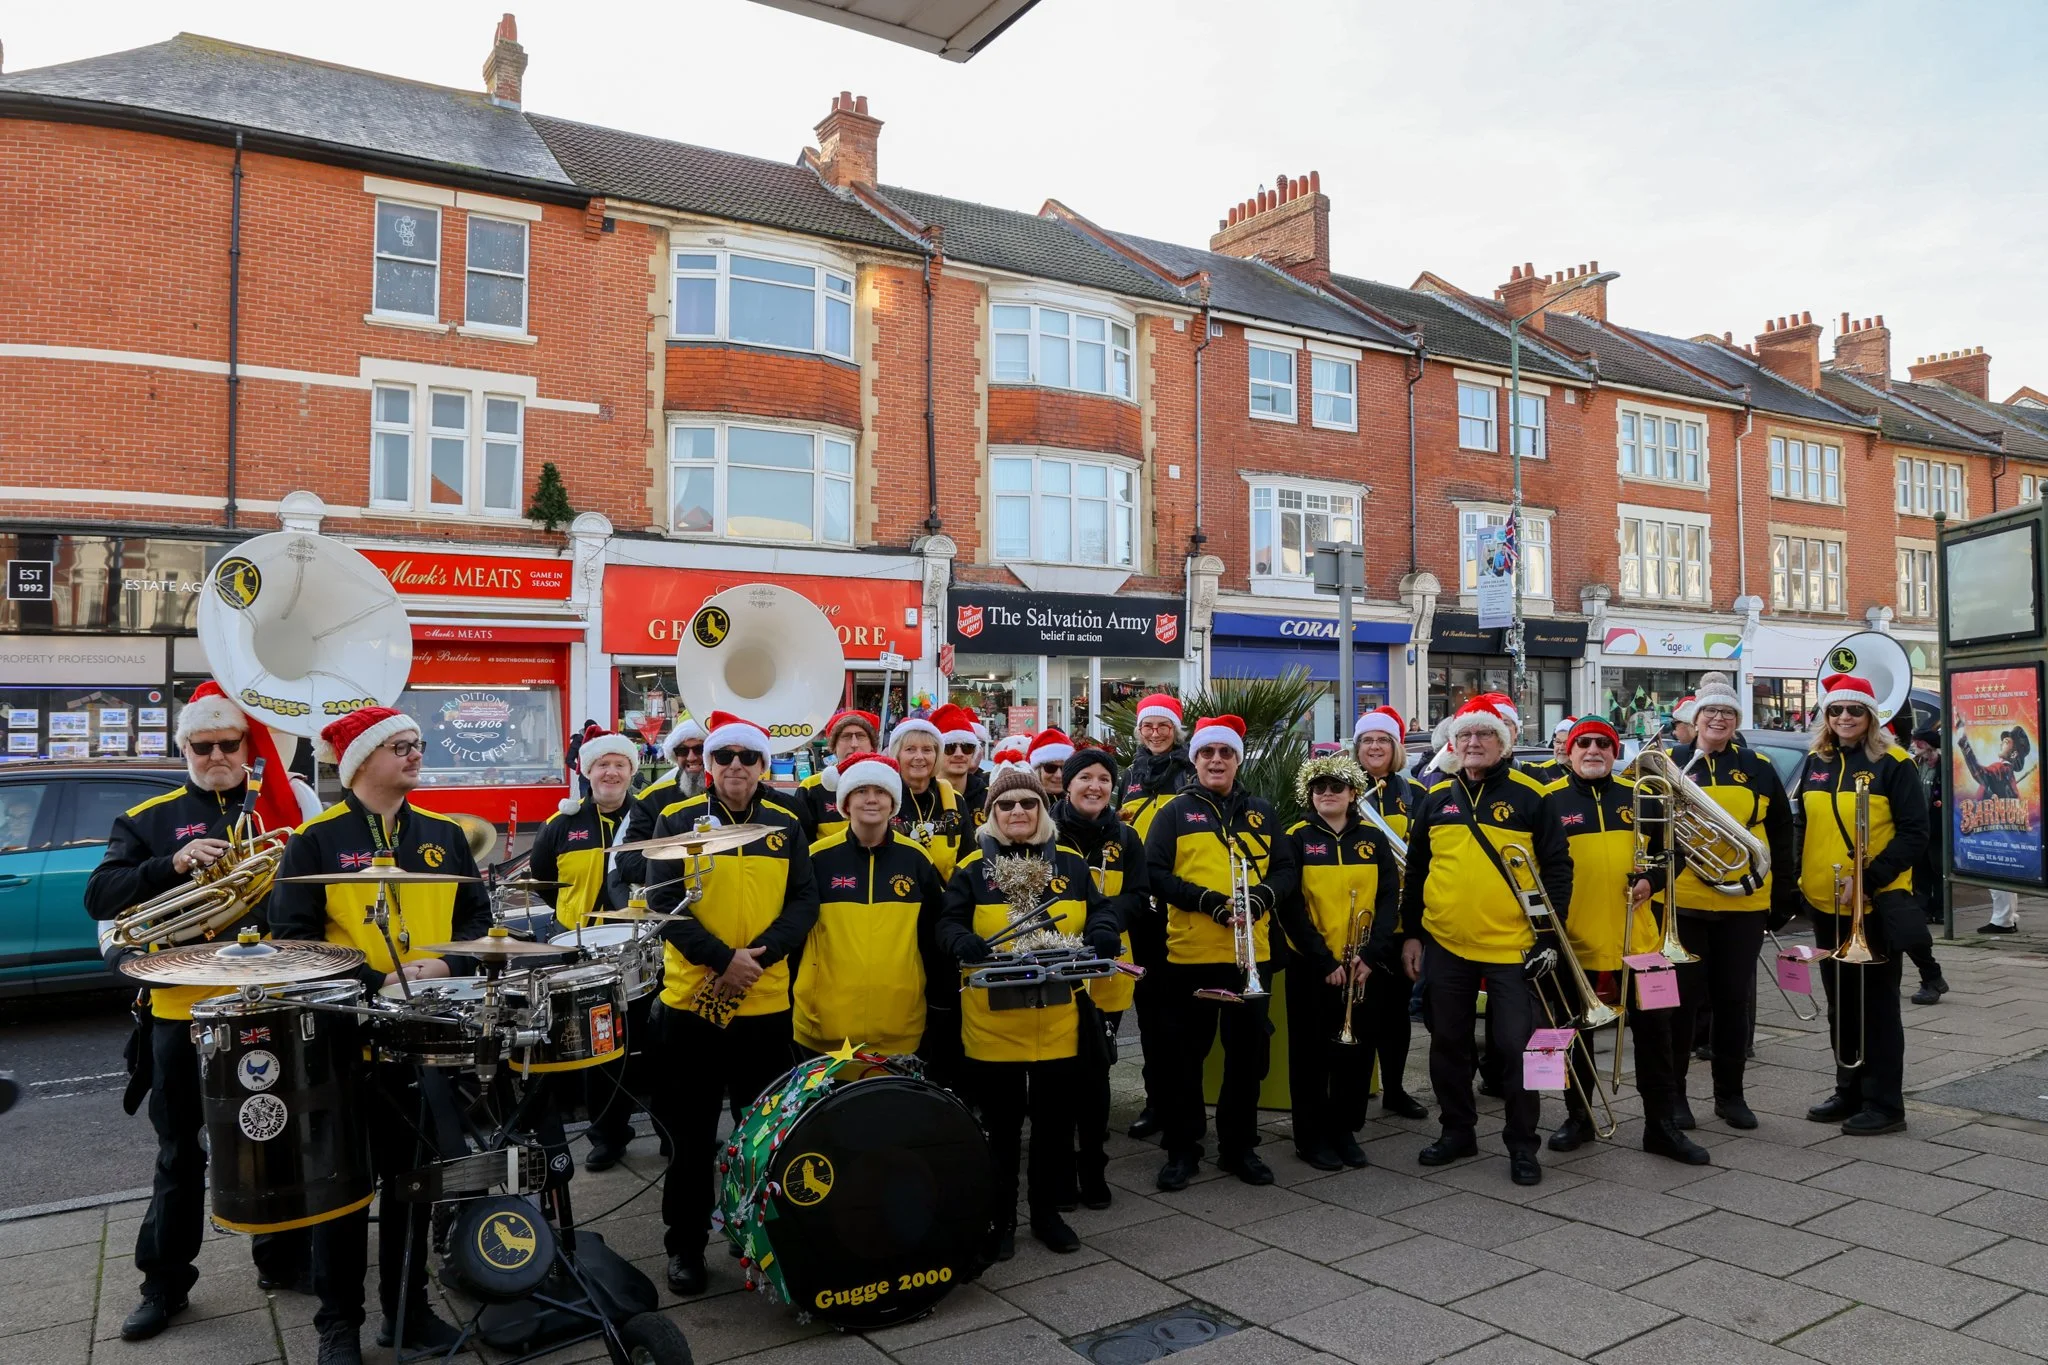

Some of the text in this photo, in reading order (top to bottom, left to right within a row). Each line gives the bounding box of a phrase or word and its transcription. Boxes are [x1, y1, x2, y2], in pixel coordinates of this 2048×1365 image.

[19, 569, 43, 580] EST
[380, 559, 522, 589] Mark's MEATS
[530, 571, 552, 579] GAME
[18, 583, 43, 593] 1992
[125, 579, 177, 592] ESTATE
[532, 579, 561, 588] SEASON
[963, 609, 973, 617] THE
[959, 613, 981, 629] SALVATION
[988, 606, 1151, 635] The Salvation Army
[458, 630, 493, 640] MEATS
[966, 624, 980, 634] ARMY
[1040, 630, 1103, 642] belief in action
[58, 655, 146, 665] PROFESSIONALS
[436, 650, 481, 663] Butchers
[240, 687, 312, 717] Gugge
[439, 691, 515, 715] TRADITIONAL
[1973, 703, 2009, 717] LEE MEAD
[768, 723, 813, 737] 2000
[441, 735, 517, 762] BUTCHERS
[1959, 793, 2033, 833] BARNUM
[815, 1266, 953, 1309] Gugge 2000
